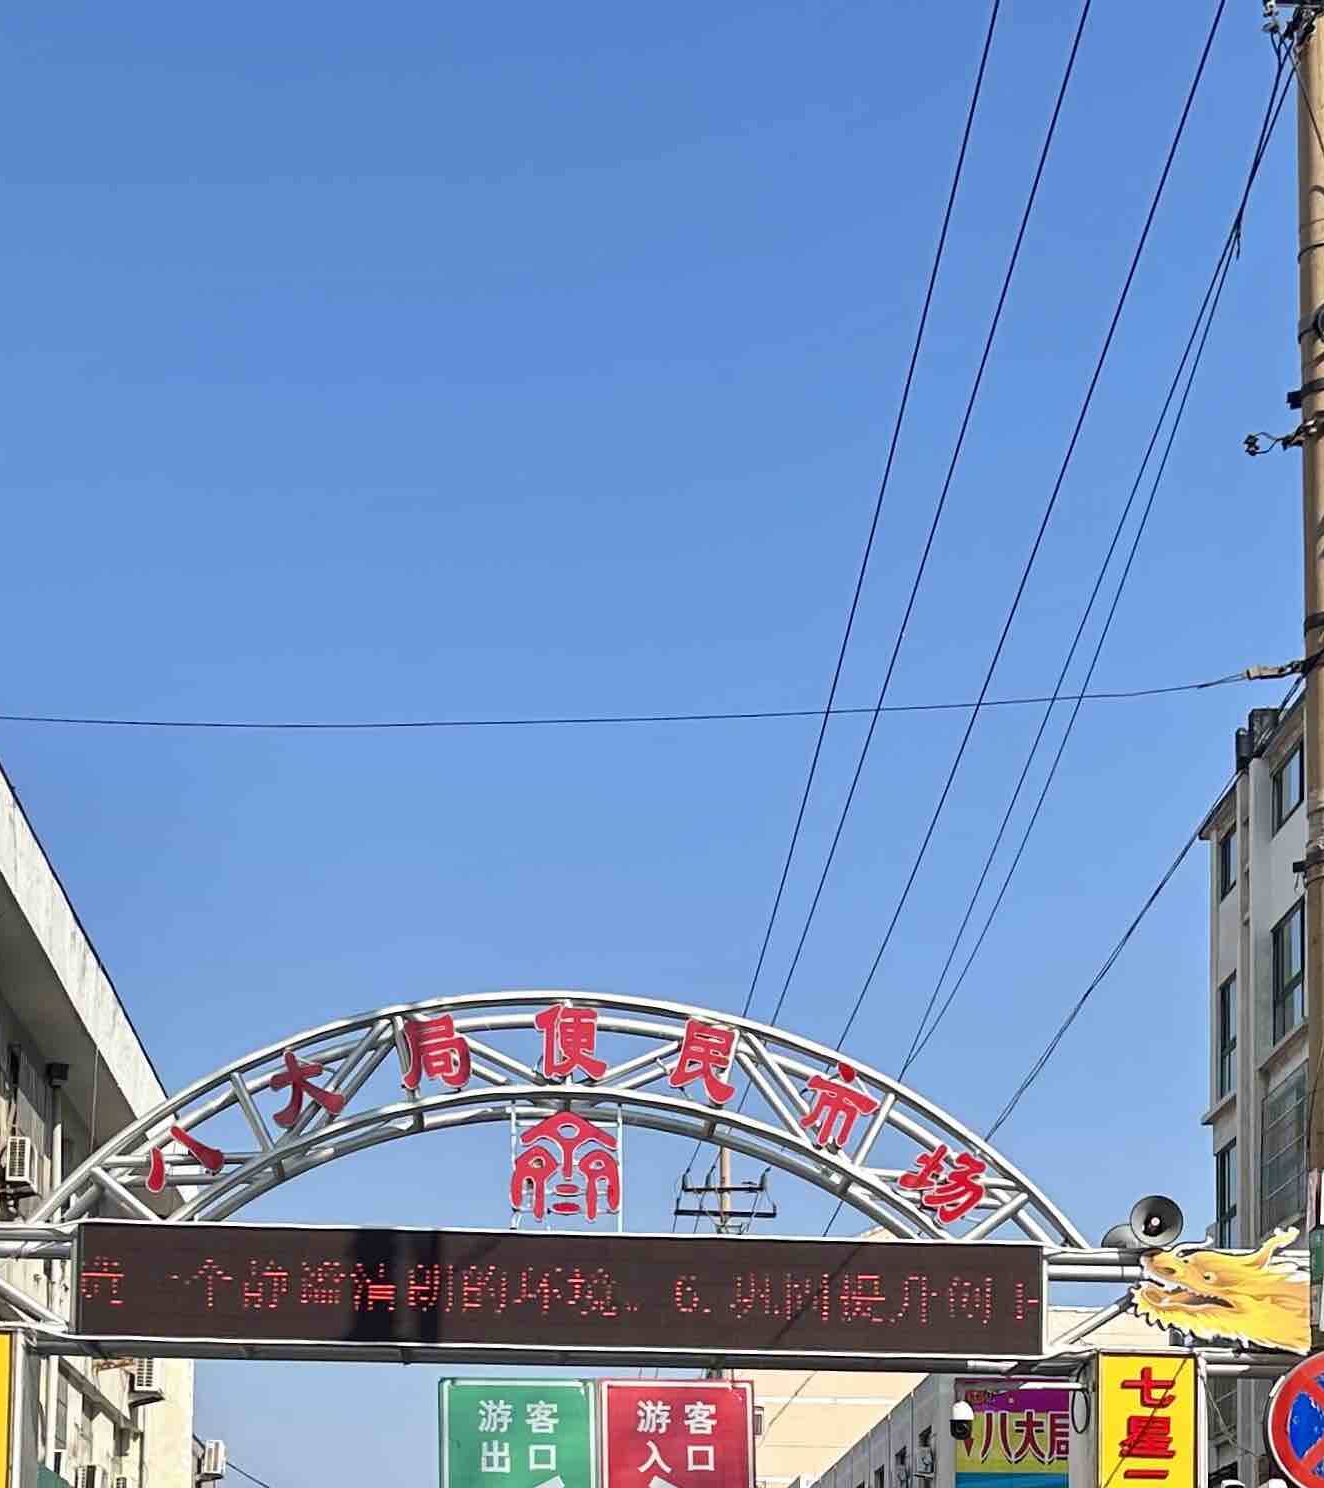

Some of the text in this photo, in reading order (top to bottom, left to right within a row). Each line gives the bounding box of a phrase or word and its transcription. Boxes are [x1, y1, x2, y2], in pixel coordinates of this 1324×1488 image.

[146, 1003, 986, 1224] 八大局便民市场
[478, 1399, 560, 1434] 游客
[637, 1400, 717, 1435] 游客
[480, 1441, 557, 1473] 出口
[637, 1441, 716, 1474] 入口
